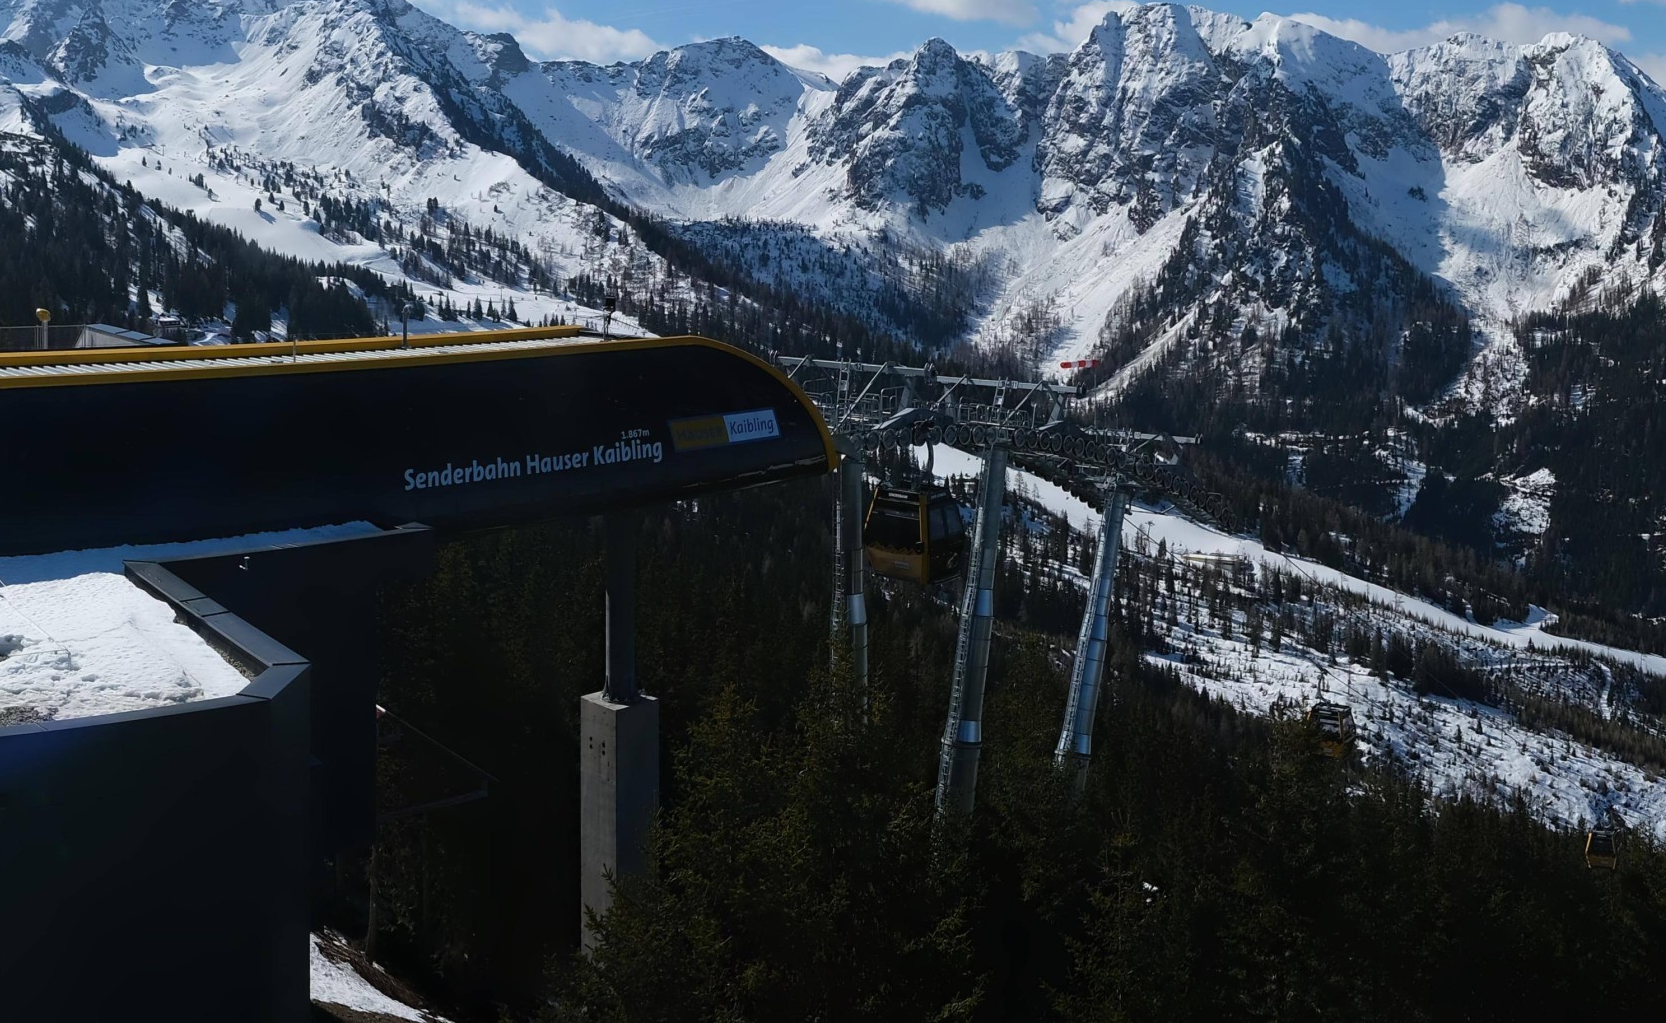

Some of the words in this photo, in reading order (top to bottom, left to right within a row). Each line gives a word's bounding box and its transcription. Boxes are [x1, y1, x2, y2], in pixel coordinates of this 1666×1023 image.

[621, 428, 650, 440] 1.867m
[676, 425, 724, 442] HAUSER
[729, 417, 775, 436] Kaibling
[404, 454, 521, 491] Senderbahn
[526, 449, 589, 474] Hauser
[593, 440, 663, 466] Kaibling
